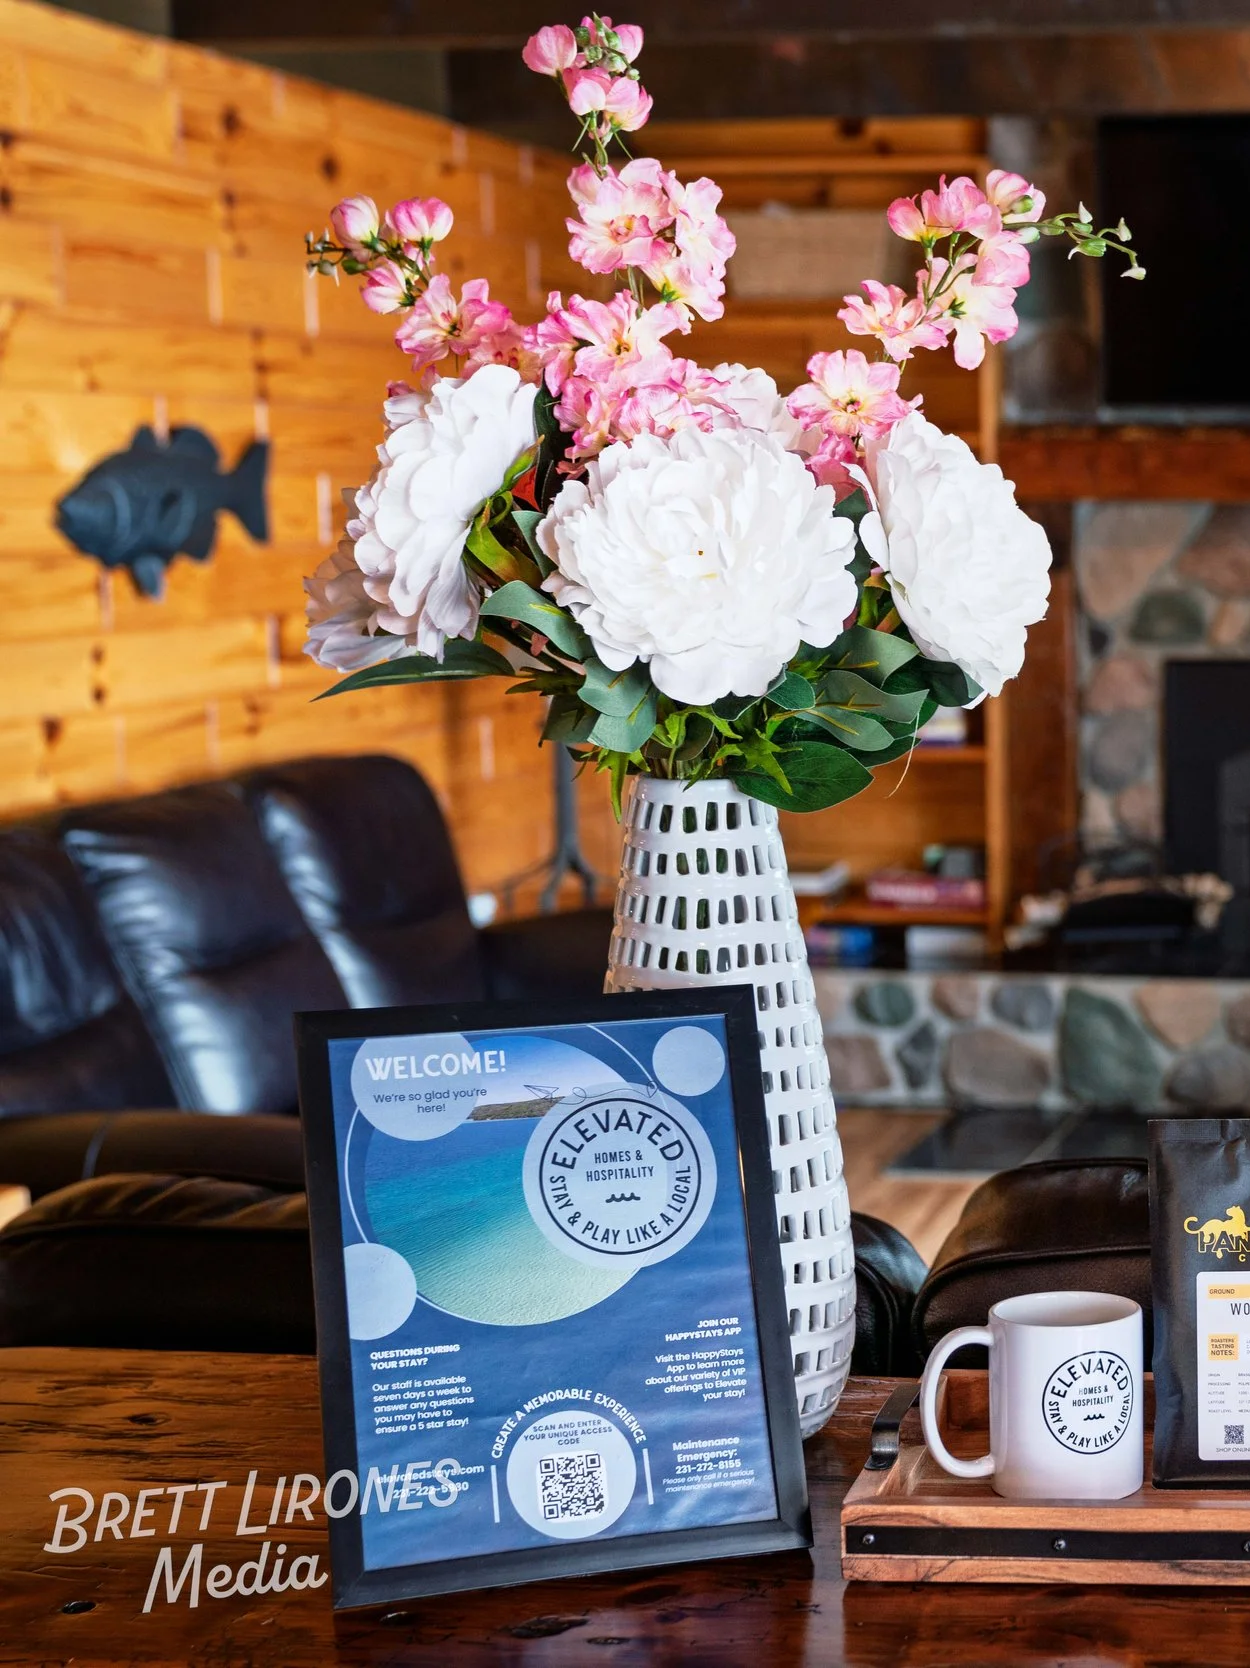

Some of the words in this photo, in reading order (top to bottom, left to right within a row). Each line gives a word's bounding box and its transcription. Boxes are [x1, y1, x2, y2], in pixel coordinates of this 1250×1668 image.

[365, 1050, 507, 1081] WELCOME!
[373, 1093, 406, 1103] We're
[408, 1092, 422, 1101] so
[424, 1090, 450, 1103] glad
[453, 1087, 487, 1100] you're
[417, 1103, 446, 1113] here!
[551, 1108, 684, 1170] ELEVATED
[594, 1150, 631, 1164] HOMES
[635, 1150, 643, 1161] &
[586, 1166, 655, 1182] HOSPITALITY
[550, 1175, 574, 1210] STAY
[567, 1211, 582, 1226] &
[582, 1221, 620, 1245] PLAY
[626, 1221, 661, 1245] LIKE
[660, 1212, 674, 1226] A
[667, 1165, 691, 1213] LOCAL
[697, 1320, 719, 1328] JOIN
[665, 1329, 723, 1341] HAPPYSTAYS
[724, 1327, 741, 1335] APP
[370, 1347, 423, 1360] QUESTIONS
[424, 1344, 460, 1354] DURING
[655, 1354, 674, 1363] Visit
[675, 1353, 690, 1361] the
[691, 1348, 744, 1360] HappyStays
[371, 1360, 397, 1370] YOUR
[399, 1358, 428, 1368] STAY?
[667, 1365, 685, 1374] App
[697, 1361, 719, 1369] learn
[372, 1383, 390, 1391] Our
[391, 1380, 413, 1389] staff
[423, 1376, 466, 1386] available
[645, 1376, 672, 1385] about
[674, 1374, 689, 1382] our
[690, 1371, 720, 1379] variety
[722, 1369, 730, 1377] of
[732, 1368, 745, 1376] VIP
[1051, 1358, 1129, 1398] ELEVATED
[664, 1383, 703, 1393] offerings
[715, 1379, 747, 1388] Elevate
[1078, 1386, 1102, 1395] HOMES
[1104, 1385, 1109, 1393] &
[373, 1393, 401, 1402] seven
[403, 1390, 426, 1400] days
[436, 1387, 460, 1396] week
[703, 1391, 722, 1402] your
[724, 1389, 745, 1398] stay!
[1072, 1395, 1114, 1407] HOSPITALITY
[374, 1403, 408, 1413] answer
[410, 1401, 428, 1410] any
[429, 1396, 474, 1409] questions
[375, 1416, 392, 1425] you
[394, 1413, 416, 1422] may
[417, 1410, 441, 1419] have
[492, 1417, 517, 1458] CREATE
[515, 1410, 526, 1421] A
[523, 1388, 592, 1412] MEMORABLE
[594, 1393, 647, 1444] EXPERIENCE
[1049, 1400, 1063, 1424] STAY
[1058, 1425, 1068, 1434] &
[1066, 1432, 1092, 1448] PLAY
[1094, 1431, 1114, 1447] LIKE
[1115, 1425, 1121, 1433] A
[1120, 1392, 1130, 1424] LOCAL
[375, 1424, 408, 1434] ensure
[418, 1422, 425, 1430] 5
[426, 1420, 444, 1429] star
[446, 1417, 469, 1427] stay!
[533, 1424, 556, 1432] SCAN
[524, 1434, 546, 1442] YOUR
[548, 1430, 578, 1439] UNIQUE
[580, 1427, 613, 1435] ACCESS
[672, 1437, 740, 1451] Maintenance
[677, 1449, 737, 1462] Emergency:
[675, 1459, 741, 1474] 231-272-8155
[665, 1483, 712, 1493] maintenance
